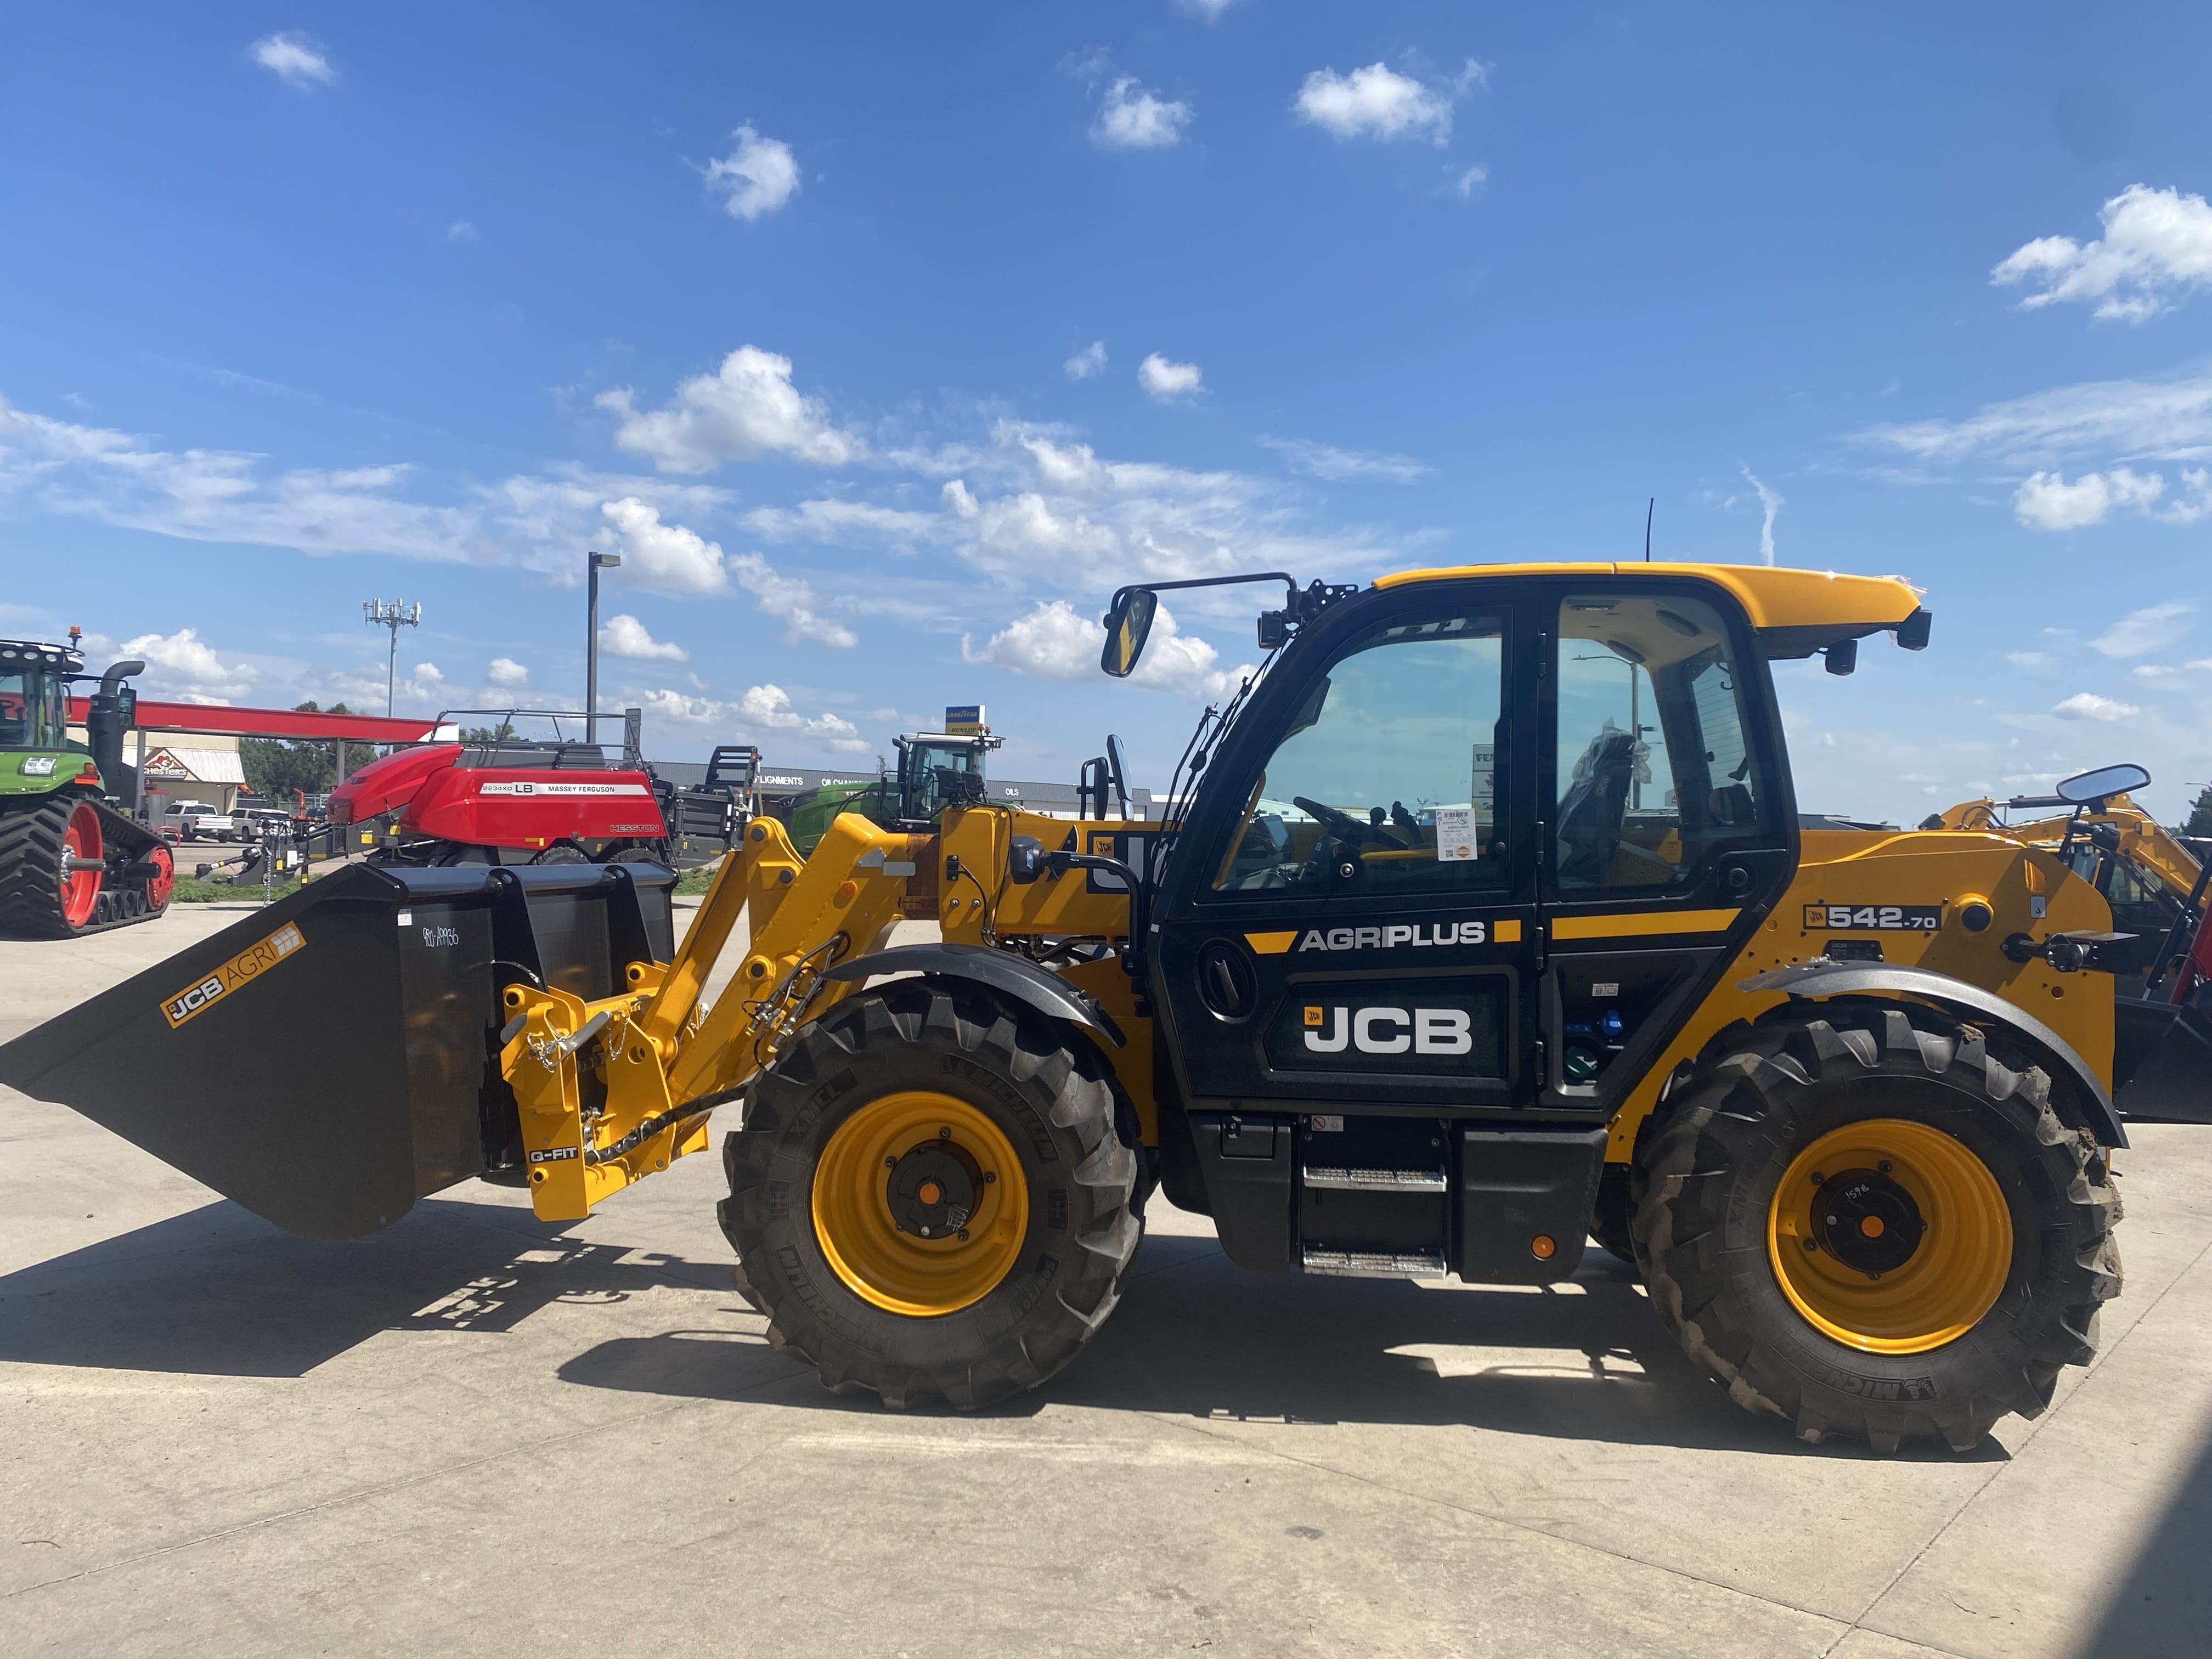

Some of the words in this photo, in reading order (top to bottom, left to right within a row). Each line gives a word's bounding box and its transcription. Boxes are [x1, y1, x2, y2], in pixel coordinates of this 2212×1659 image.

[516, 785, 533, 793] LB
[1098, 842, 1112, 852] JCB
[1298, 922, 1485, 952] AGRIPLUS
[172, 977, 223, 1019] JCB
[227, 941, 276, 988] AGRI
[1305, 1007, 1472, 1054] JCB
[789, 1084, 842, 1142] XMCL
[969, 1067, 1059, 1159] MICHELIN
[531, 1147, 577, 1162] Q-FIT
[778, 1250, 864, 1343] MICHELIN
[1773, 1336, 1900, 1401] MICHELIN
